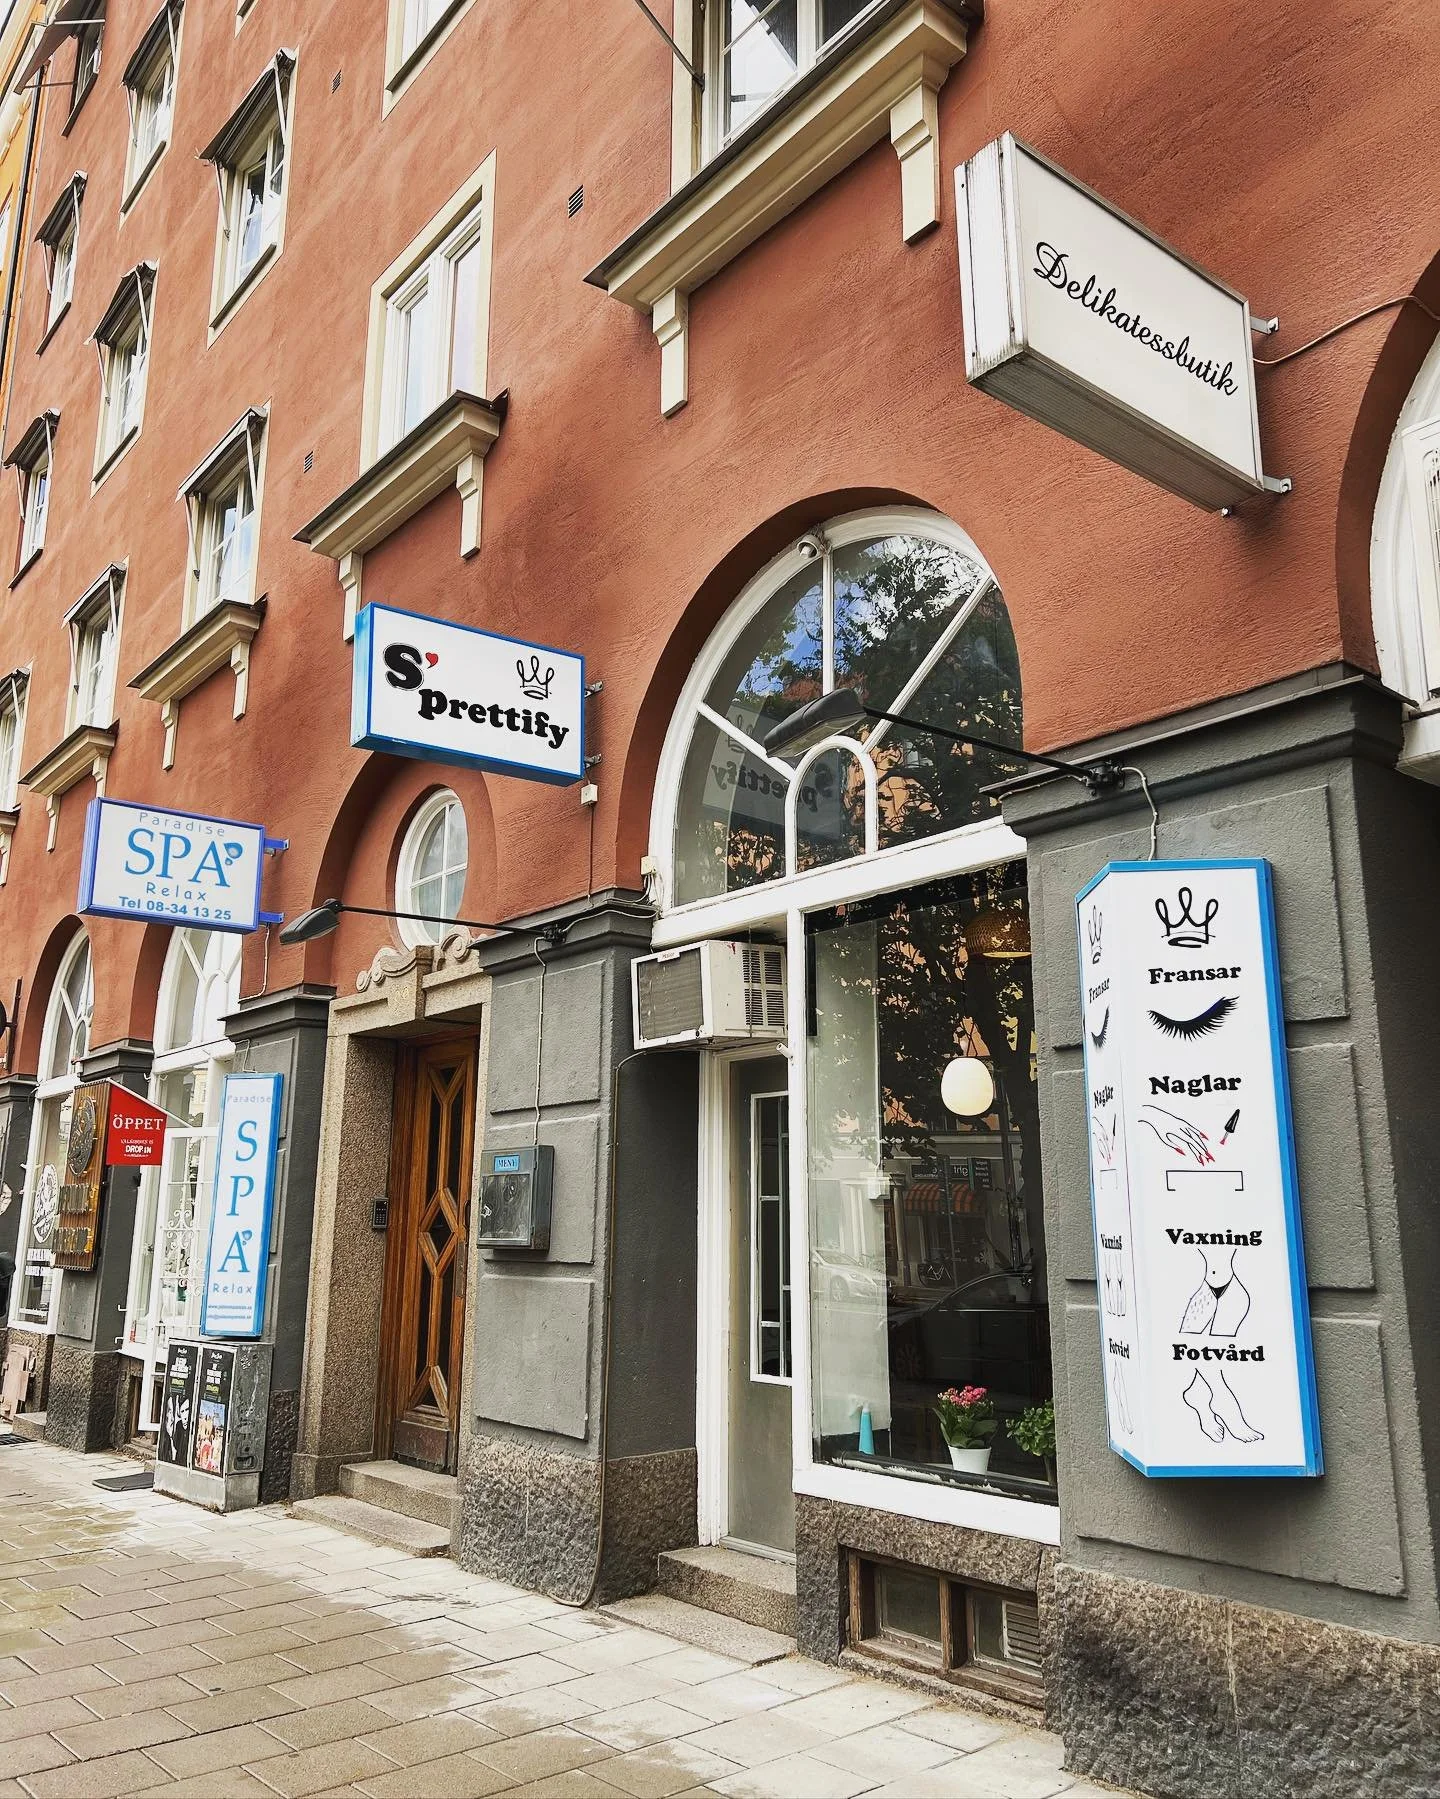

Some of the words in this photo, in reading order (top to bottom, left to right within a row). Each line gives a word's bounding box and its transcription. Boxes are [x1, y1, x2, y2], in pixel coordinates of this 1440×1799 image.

[1033, 242, 1238, 396] Delikatessbutik
[418, 688, 570, 749] prettify
[139, 812, 225, 837] Paradise
[124, 827, 231, 888] SPA
[146, 881, 207, 901] Relax
[119, 896, 141, 909] Tel
[146, 900, 188, 915] 08-34
[193, 905, 210, 918] 13
[214, 908, 232, 921] 25
[1148, 966, 1242, 985] Fransar
[1089, 977, 1110, 1004] Fransar
[1094, 1085, 1114, 1108] Naglar
[1148, 1074, 1242, 1098] Naglar
[112, 1113, 164, 1131] ÖPPET
[498, 1158, 517, 1167] MENY
[1101, 1234, 1123, 1250] Vaxning
[1165, 1228, 1263, 1247] Vaxning
[213, 1282, 253, 1294] Relax
[1109, 1338, 1130, 1359] Fotvård
[1172, 1343, 1266, 1362] Fotvård
